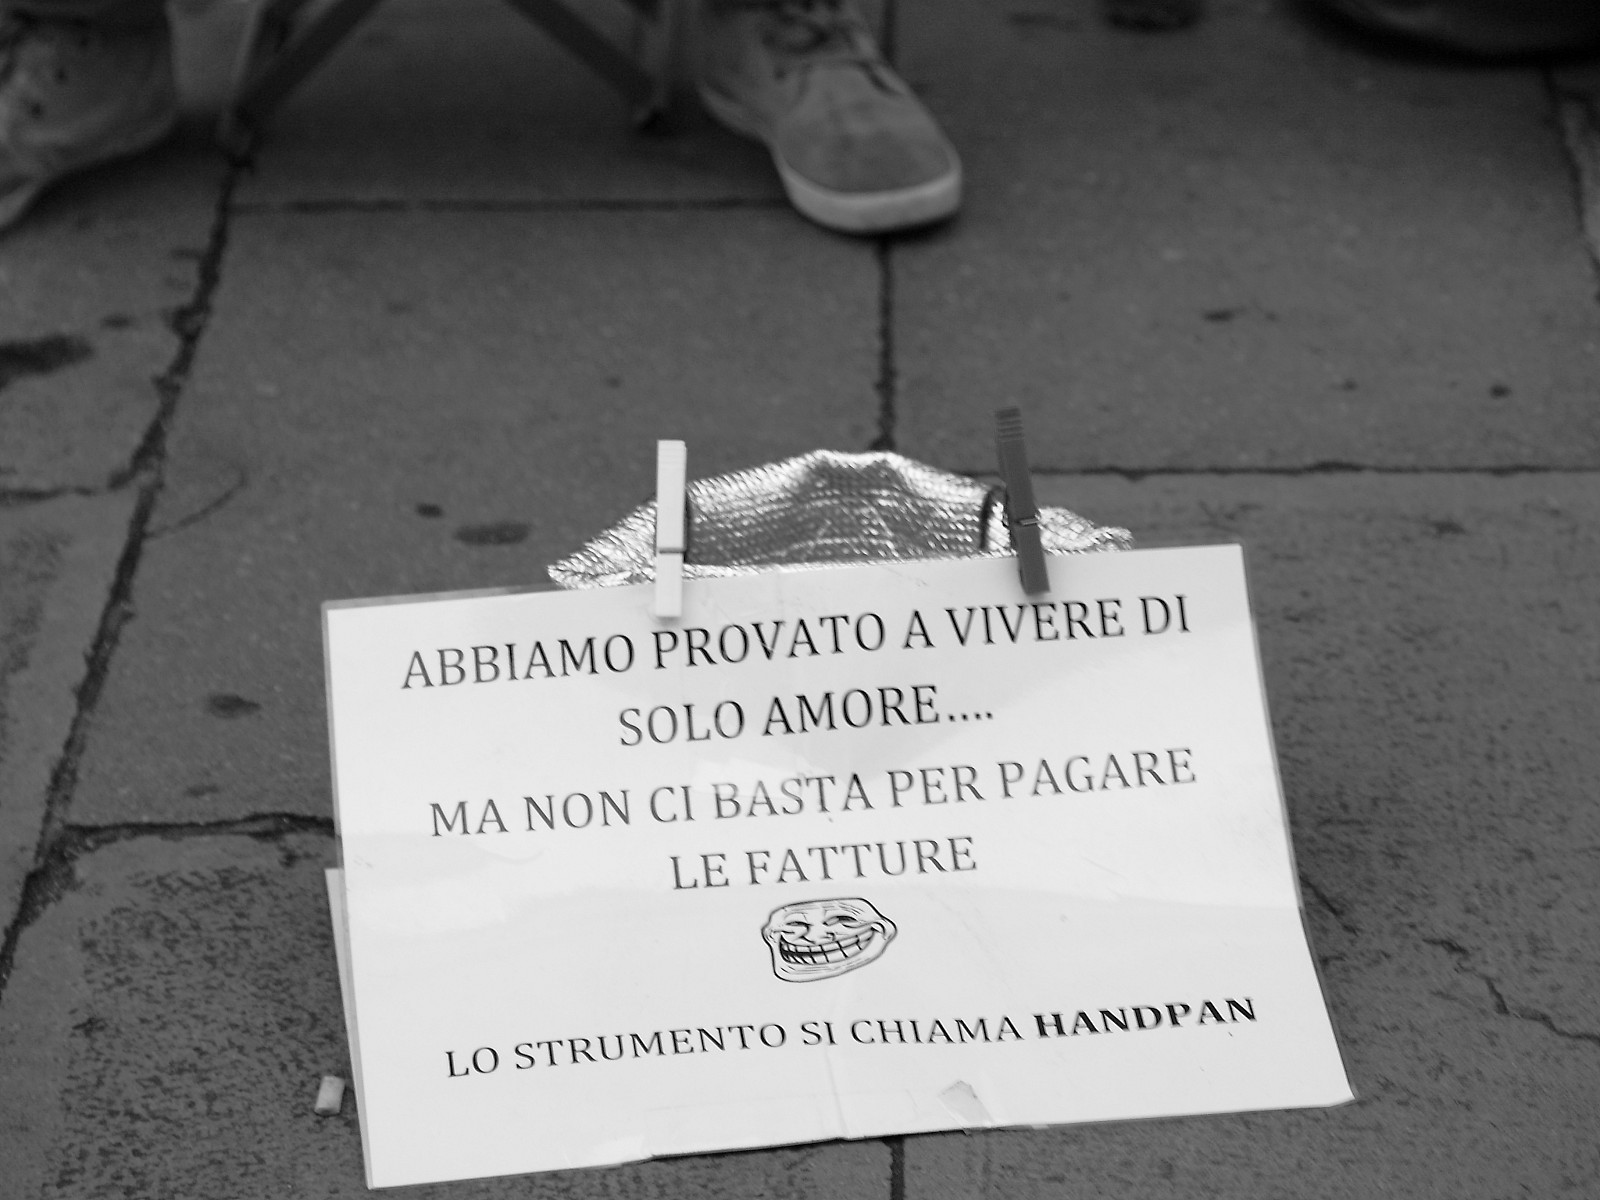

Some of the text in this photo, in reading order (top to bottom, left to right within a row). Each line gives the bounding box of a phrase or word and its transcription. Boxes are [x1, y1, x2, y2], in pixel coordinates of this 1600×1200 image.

[401, 594, 1190, 689] ABBIAMO PROVATO A VIVERE DI
[619, 684, 993, 746] SOLO AMORE....
[429, 747, 1196, 837] MA NON CI BASTA PER PAGARE
[669, 836, 977, 890] LE FATTURE
[445, 997, 1257, 1078] LO STRUMENTO SI CHIAMA HANDPAN
